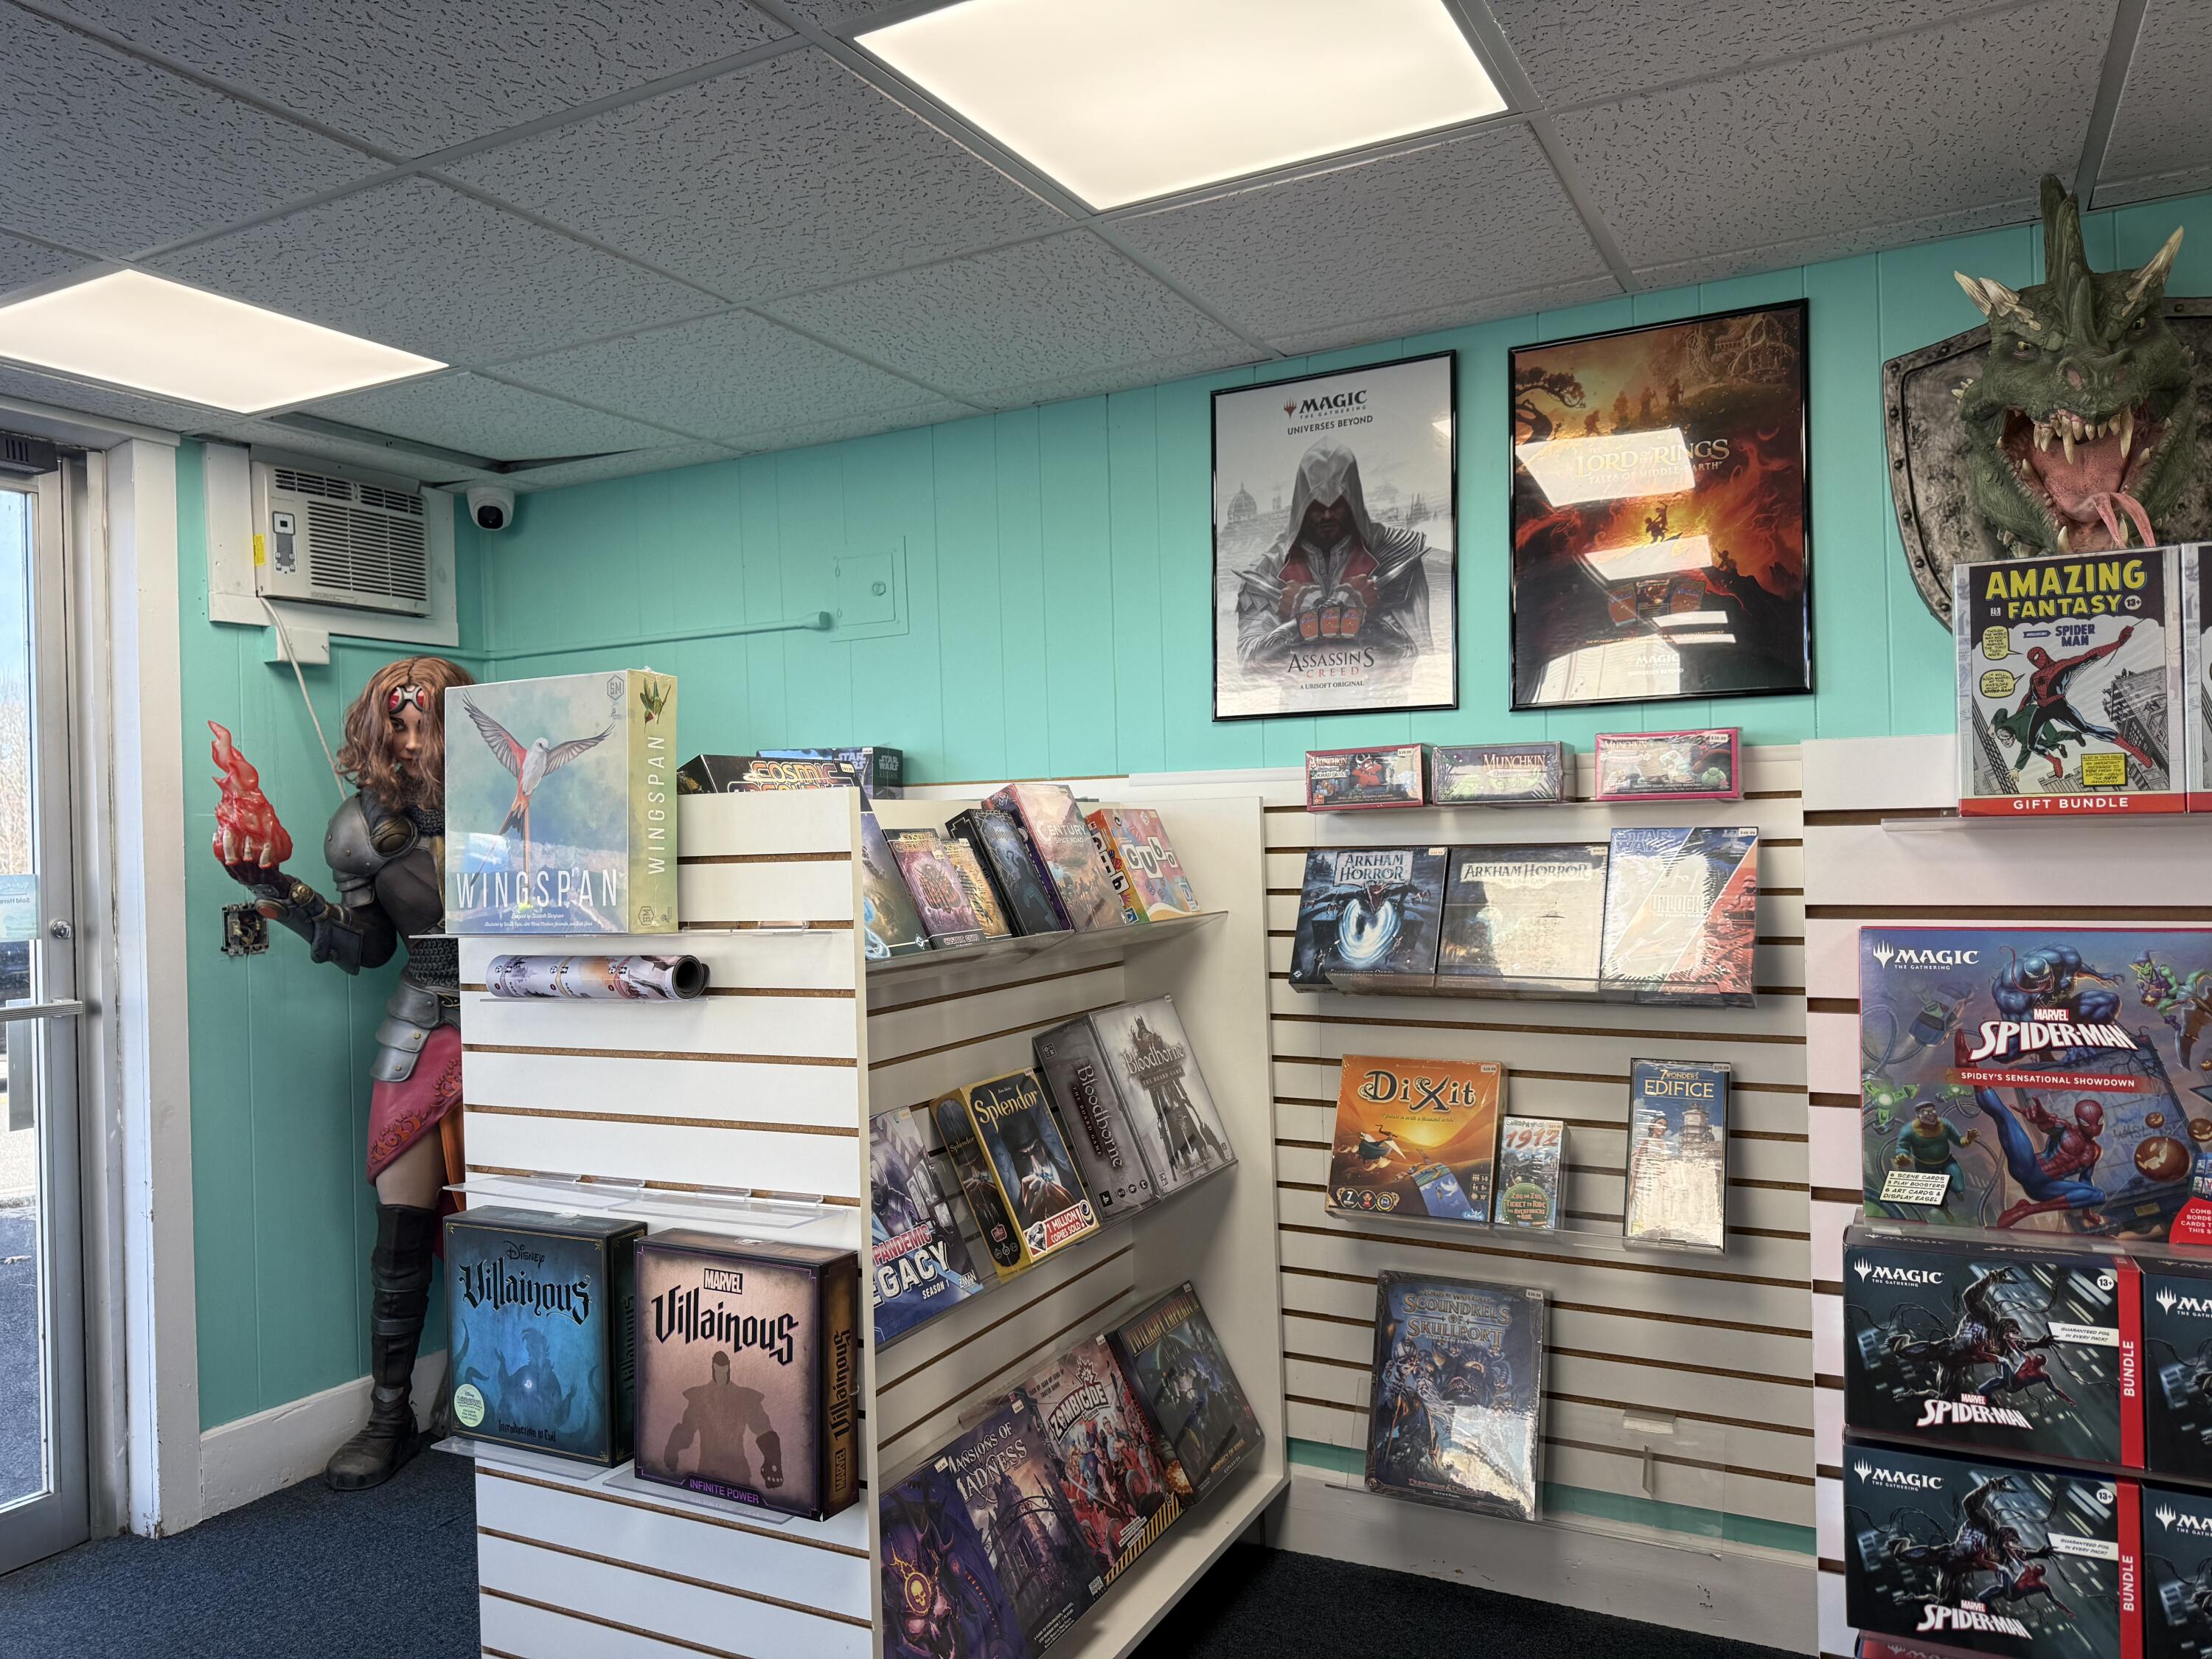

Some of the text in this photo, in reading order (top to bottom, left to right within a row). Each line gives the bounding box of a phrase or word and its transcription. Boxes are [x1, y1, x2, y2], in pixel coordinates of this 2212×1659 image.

[1298, 389, 1368, 414] MAGIC
[1318, 405, 1367, 417] GATHERING
[1287, 415, 1374, 435] UNIVERSES BEYOND
[1576, 439, 1730, 478] LORD RINGS
[1589, 474, 1618, 484] TALES
[1986, 559, 2148, 601] AMAZING
[2008, 594, 2141, 619] FANTASY 13+
[2055, 624, 2096, 636] SPIDER
[2062, 635, 2090, 647] MAN
[1287, 647, 1375, 672] ASSASSIN'S
[1635, 654, 1680, 664] MAGIC
[1306, 666, 1360, 678] CREED
[1604, 740, 1647, 750] MUNCHKIN
[834, 752, 866, 762] STAR
[879, 755, 899, 763] STAR
[879, 762, 899, 771] WARS
[1310, 756, 1348, 768] MUNCHKIN
[1483, 754, 1546, 771] MUNCHKIN
[750, 761, 838, 784] COSMIC
[647, 736, 666, 875] WINGSPAN
[2013, 797, 2129, 810] GIFT BUNDLE
[1036, 821, 1087, 843] CENTURY
[1615, 828, 1676, 842] STAR
[1344, 854, 1404, 868] ARKHAM
[1339, 866, 1405, 882] HORROR
[1464, 863, 1590, 880] ARKHAM HORROR
[456, 868, 617, 909] WINGSPAN
[1893, 949, 1980, 966] MAGIC
[2034, 1009, 2069, 1022] MARVEL
[1968, 1020, 2139, 1063] SPIDER-MAN
[1122, 1043, 1184, 1075] Bloodborne
[1660, 1069, 1700, 1080] 7 WONDERS
[1961, 1071, 2135, 1088] SPIDEY'S SENSATIONAL SHOWDOWN
[1644, 1079, 1715, 1099] EDIFICE
[974, 1083, 1038, 1134] Splendor
[1076, 1065, 1124, 1169] Bloodborne
[1079, 1105, 1093, 1132] BOARD
[1091, 1134, 1103, 1157] GAME
[1505, 1127, 1560, 1150] 1912
[950, 1136, 975, 1154] Splendor
[1052, 1210, 1078, 1229] MILLION
[872, 1222, 933, 1267] PANDEMIC
[1051, 1228, 1068, 1244] COPIES
[704, 1269, 742, 1295] MARVEL
[1871, 1266, 1944, 1285] MAGIC
[2098, 1279, 2113, 1287] 13+
[458, 1256, 594, 1326] Villainous
[922, 1281, 945, 1300] SEASON
[1402, 1293, 1512, 1326] SCOUNDRELS
[1447, 1313, 1464, 1325] OF
[650, 1284, 799, 1367] Villainous
[1406, 1317, 1504, 1348] SKULLPORT
[2060, 1326, 2098, 1335] GUARANTEED
[2122, 1340, 2135, 1397] BUNDLE
[829, 1329, 851, 1441] Villainous
[1961, 1393, 1986, 1405] MARVEL
[1049, 1384, 1107, 1438] ZOMBICIDE
[1916, 1399, 2034, 1430] SPIDER-MAN
[498, 1419, 537, 1439] Introduction
[544, 1429, 557, 1443] Evil
[998, 1422, 1012, 1439] OF
[835, 1447, 846, 1492] MARVEL
[1871, 1466, 1944, 1489] MAGIC
[689, 1478, 759, 1505] INFINITE POWER
[1886, 1483, 1919, 1492] GATHERING
[2098, 1492, 2112, 1500] 13+
[2060, 1538, 2097, 1548] GUARANTEED
[2122, 1555, 2135, 1612] BUNDLE
[1961, 1599, 1986, 1613] MARVEL
[1916, 1604, 2034, 1640] SPIDER-MAN
